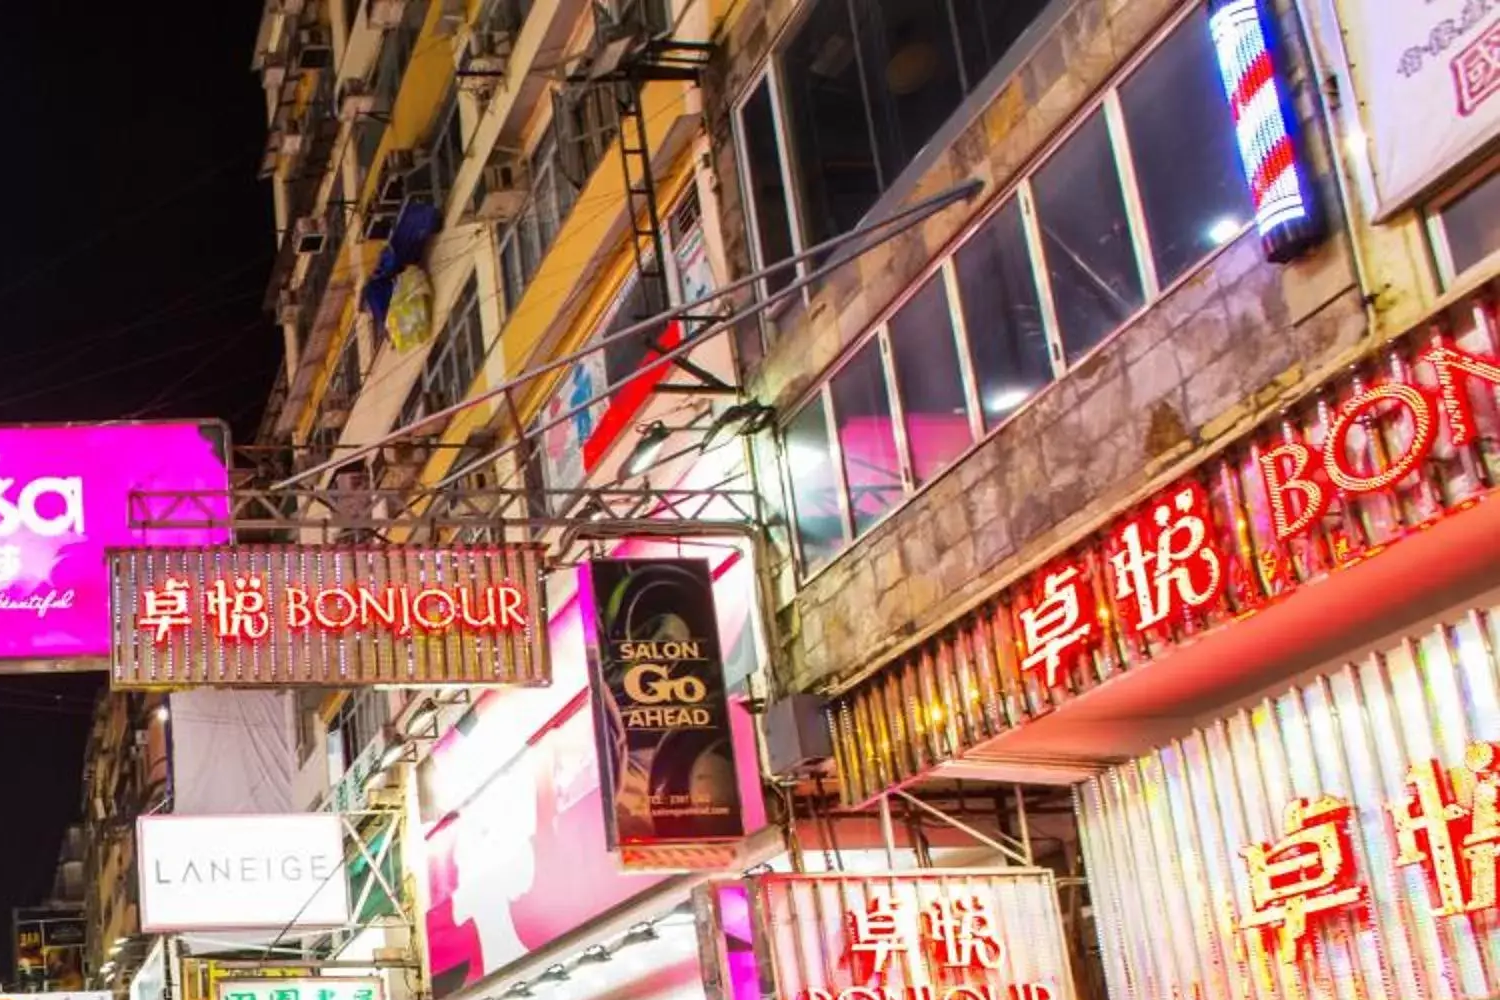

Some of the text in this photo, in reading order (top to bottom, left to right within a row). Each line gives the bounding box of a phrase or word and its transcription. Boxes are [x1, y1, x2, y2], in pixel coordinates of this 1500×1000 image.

[286, 586, 526, 635] BONJOUR
[620, 642, 699, 660] SALON
[623, 663, 707, 705] Go
[628, 707, 710, 728] AHEAD
[155, 856, 329, 884] LANEIGE
